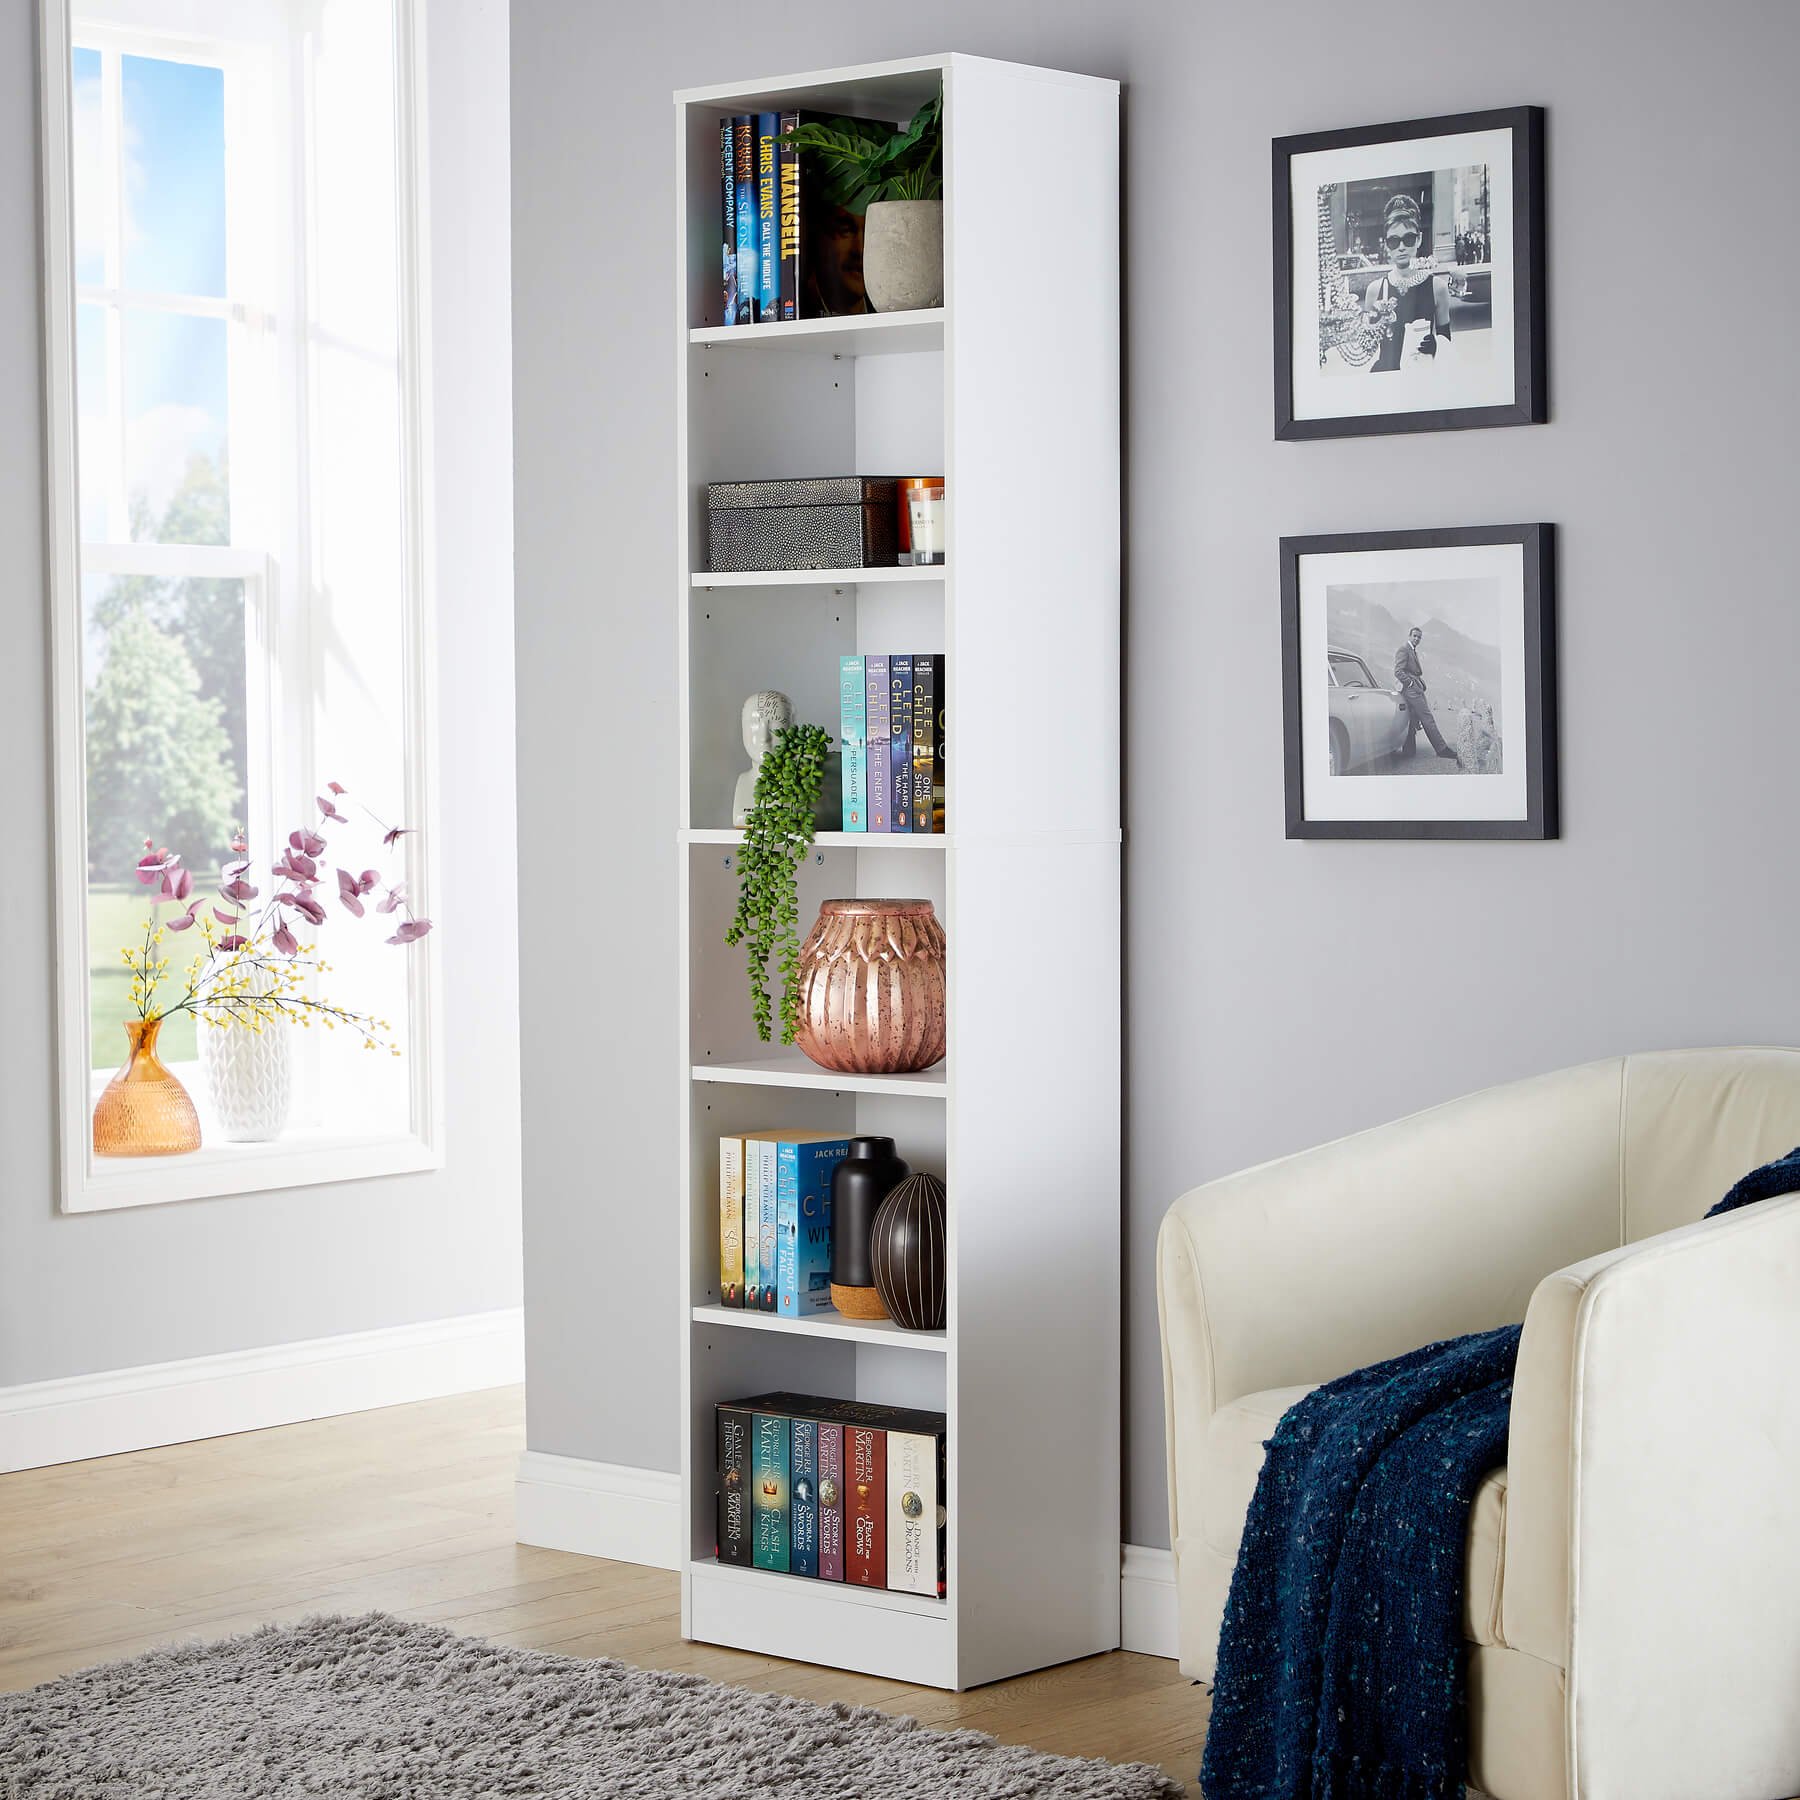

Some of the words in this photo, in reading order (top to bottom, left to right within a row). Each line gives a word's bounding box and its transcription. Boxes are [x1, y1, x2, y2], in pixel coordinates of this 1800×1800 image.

[725, 126, 734, 172] VINCENT
[760, 136, 773, 174] CHRIS
[726, 176, 735, 227] KOMPANY
[761, 178, 773, 219] EVANS
[781, 163, 800, 260] MANSELL
[763, 222, 771, 241] CALL
[763, 243, 771, 257] THE
[763, 262, 771, 290] MIDLIFE
[868, 682, 878, 736] CHILD
[880, 692, 888, 724] LEE
[892, 680, 902, 735] CHILD
[903, 690, 912, 723] LEE
[914, 684, 924, 738] CHILD
[924, 696, 933, 728] LEE
[874, 747, 882, 767] THE
[850, 751, 858, 804] PERSUADER
[874, 771, 883, 808] ENEMY
[914, 773, 923, 804] SHOT
[922, 777, 931, 801] ONE
[814, 1150, 834, 1158] JACK
[779, 1250, 787, 1274] FAIL
[786, 1236, 794, 1292] WITHOUT
[724, 1420, 734, 1470] THRONES
[734, 1425, 744, 1460] GAME
[760, 1419, 773, 1478] MARTIN
[772, 1420, 780, 1457] GEORGE
[795, 1422, 804, 1474] MARTIN
[804, 1424, 812, 1458] GEORGE
[820, 1427, 830, 1480] MARTIN
[830, 1429, 838, 1462] GEORGE
[856, 1430, 866, 1482] MARTIN
[866, 1432, 874, 1465] GEORGE
[728, 1492, 737, 1540] MARTIN
[761, 1514, 770, 1552] KINGS
[771, 1508, 780, 1552] CLASH
[798, 1504, 806, 1551] SWORDS
[806, 1513, 814, 1543] STORM
[824, 1508, 832, 1554] SWORDS
[832, 1516, 840, 1546] STORM
[866, 1521, 874, 1549] FEAST
[856, 1517, 866, 1556] CROWS
[906, 1520, 914, 1574] DRAGONS
[913, 1528, 922, 1558] DANCE
